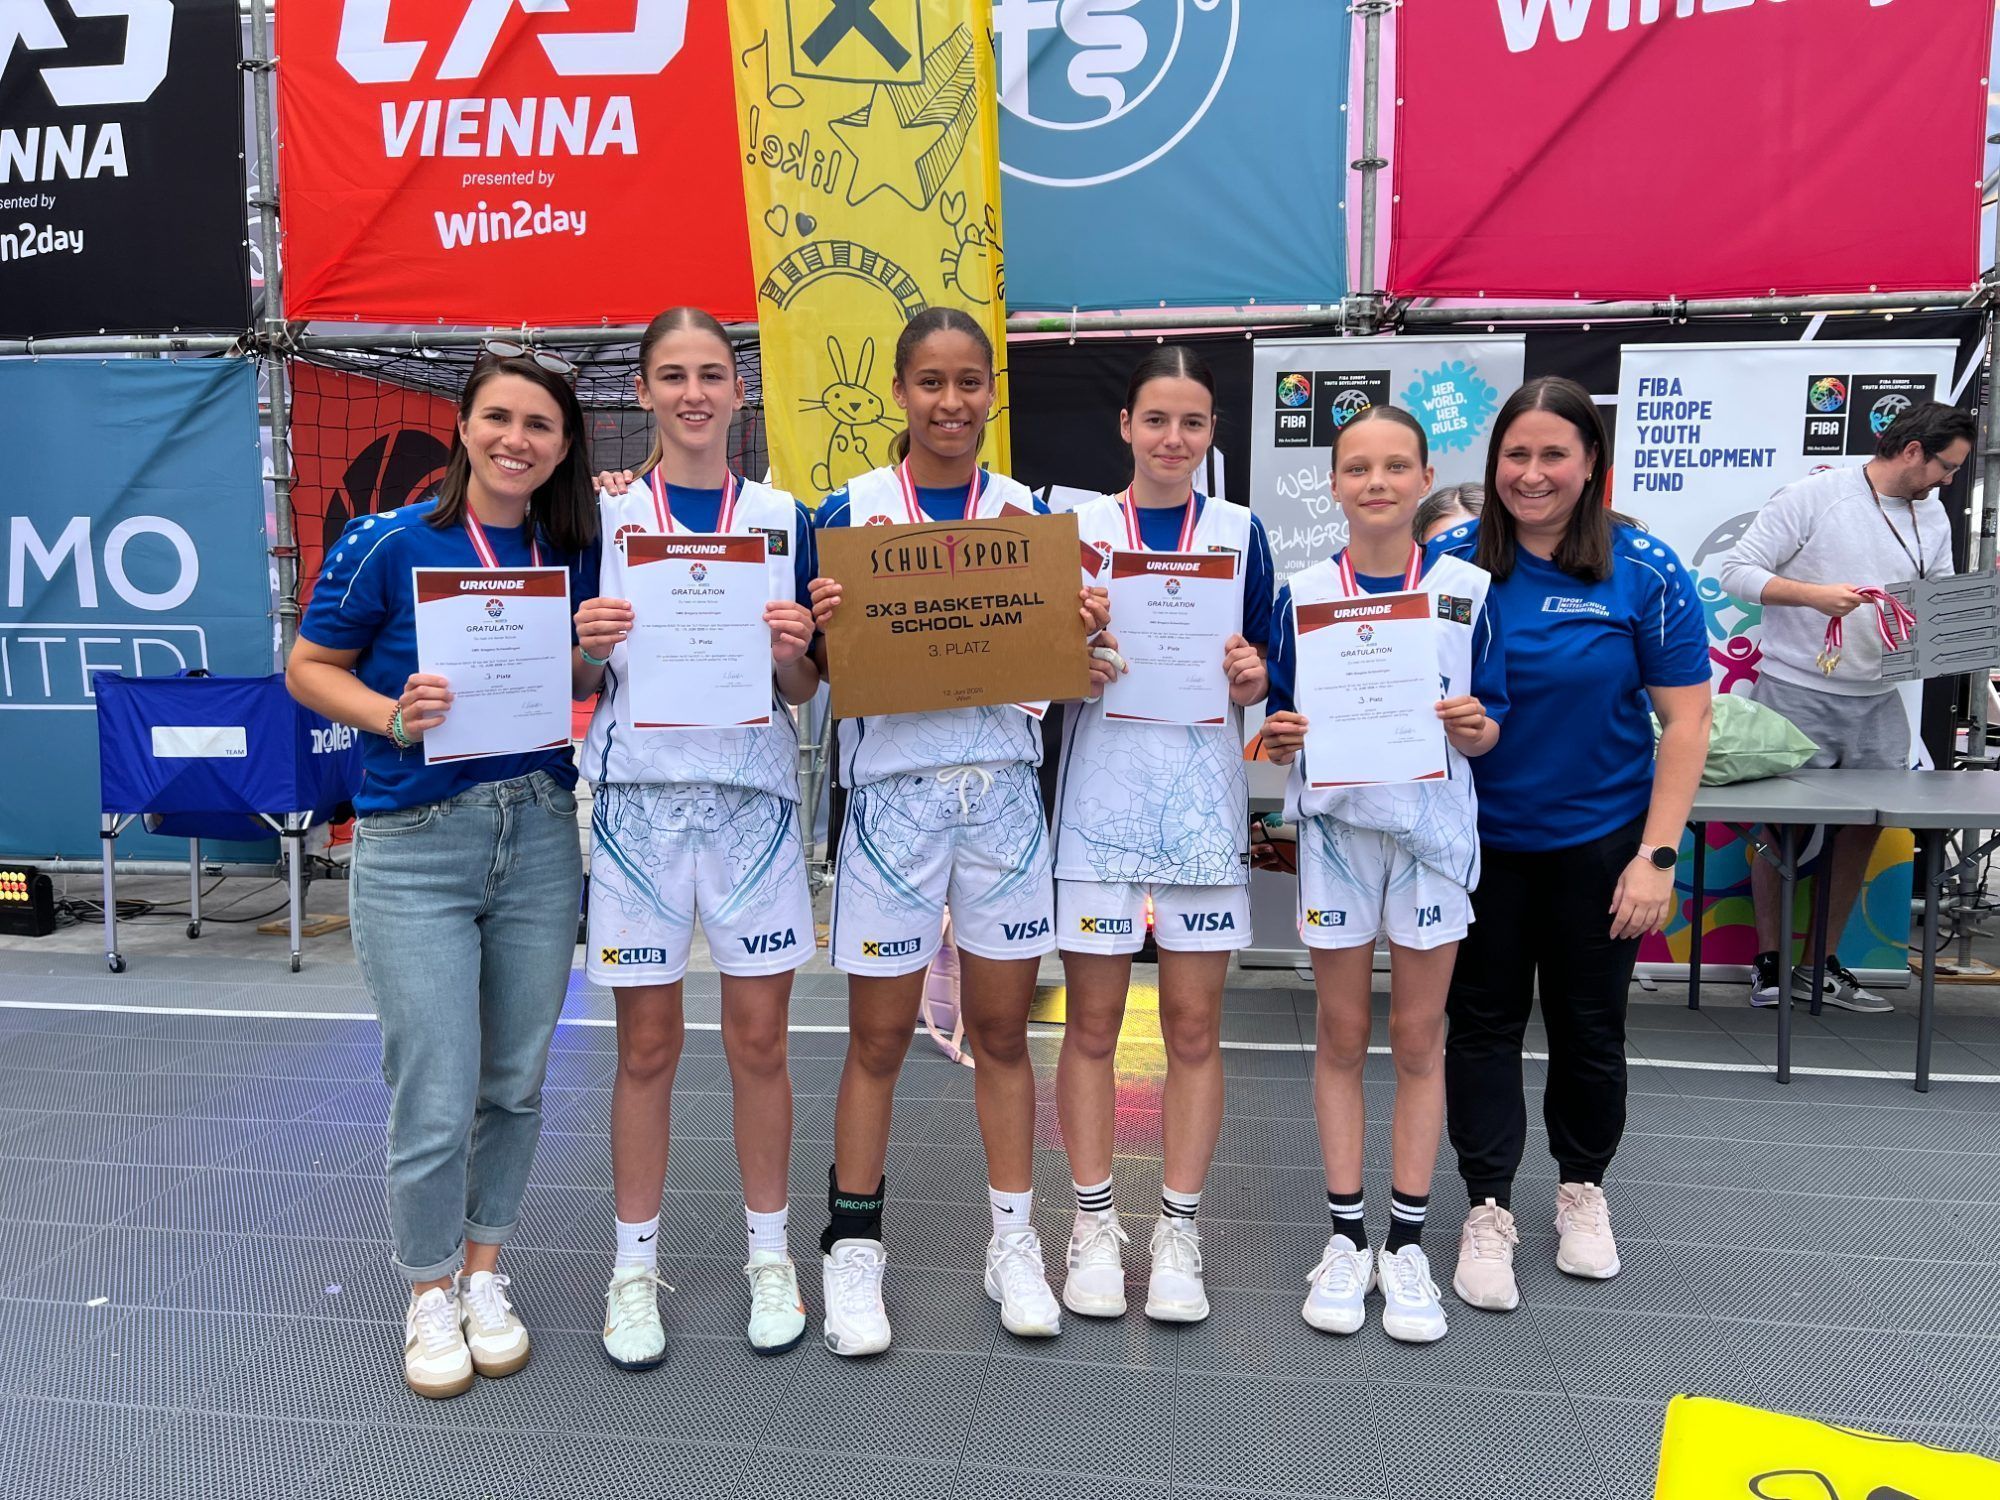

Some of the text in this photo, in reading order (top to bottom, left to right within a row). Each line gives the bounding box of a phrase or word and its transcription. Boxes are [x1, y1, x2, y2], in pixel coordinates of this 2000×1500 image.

[381, 95, 639, 158] VIENNA
[462, 169, 556, 189] presented by
[40, 193, 56, 210] by
[433, 200, 587, 250] win2day
[1431, 381, 1455, 397] HER
[1638, 377, 1683, 397] FIBA
[1422, 392, 1468, 411] WORLD,
[1637, 400, 1713, 421] EUROPE
[1280, 415, 1306, 428] FIBA
[1436, 405, 1459, 421] HER
[1431, 416, 1468, 435] RULES
[1810, 421, 1840, 436] FIBA
[1637, 425, 1701, 445] YOUTH
[1634, 448, 1777, 468] DEVELOPMENT
[1633, 472, 1684, 492] FUND
[1301, 494, 1331, 519] TO
[666, 544, 727, 554] URKUNDE
[870, 539, 1030, 574] SCHUL SPORT
[8, 515, 199, 611] MO
[1146, 561, 1201, 571] URKUNDE
[459, 579, 525, 590] URKUNDE
[671, 588, 725, 596] GRATULATION
[865, 592, 1045, 618] 3X3 BASKETBALL
[1147, 600, 1195, 608] GRATULATION
[1333, 604, 1393, 619] URKUNDE
[466, 624, 524, 633] GRATULATION
[891, 611, 1023, 634] SCHOOL JAM
[928, 640, 991, 658] 3. PLATZ
[1340, 647, 1393, 657] GRATULATION
[999, 917, 1051, 941] VISA
[1095, 919, 1131, 934] CLUB
[1178, 912, 1235, 932] VISA
[737, 927, 797, 955] VISA
[878, 940, 919, 956] CLUB
[618, 951, 663, 964] CLUB
[834, 1198, 884, 1210] AIRCAST
